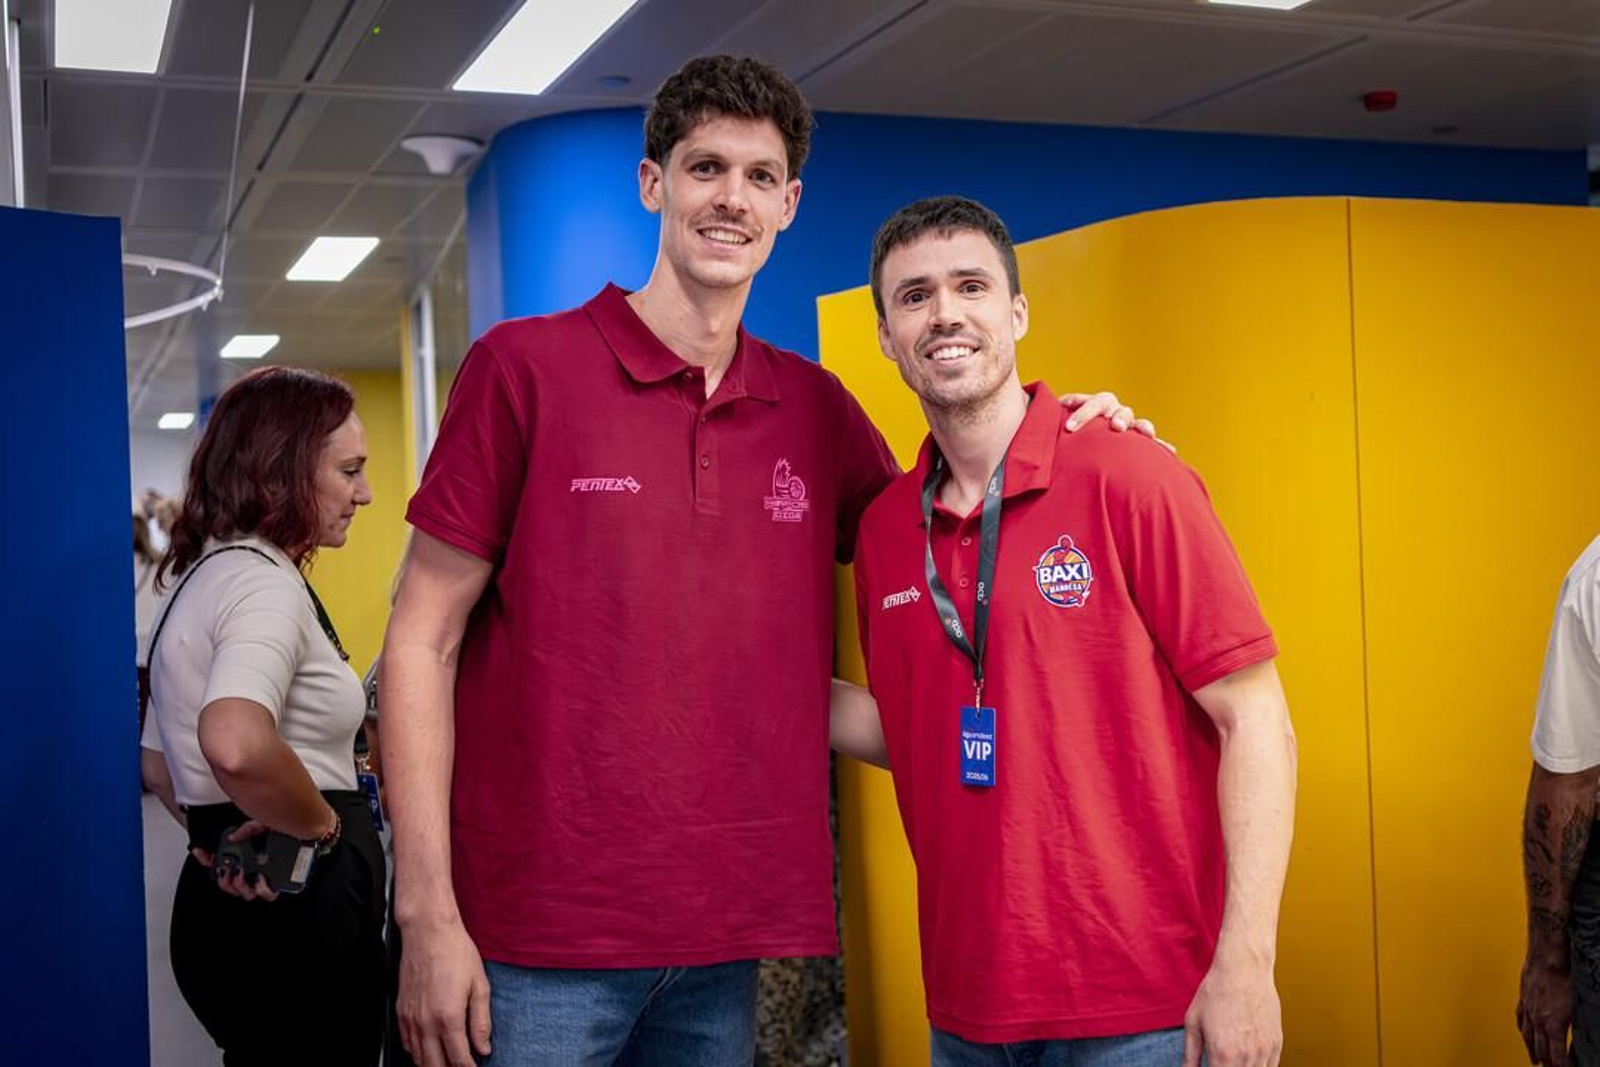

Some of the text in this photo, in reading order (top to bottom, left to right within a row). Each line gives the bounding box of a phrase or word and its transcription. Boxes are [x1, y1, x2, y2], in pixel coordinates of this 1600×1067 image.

[570, 478, 626, 492] PENTEX
[1040, 562, 1089, 584] BAXI
[964, 741, 992, 760] VIP
